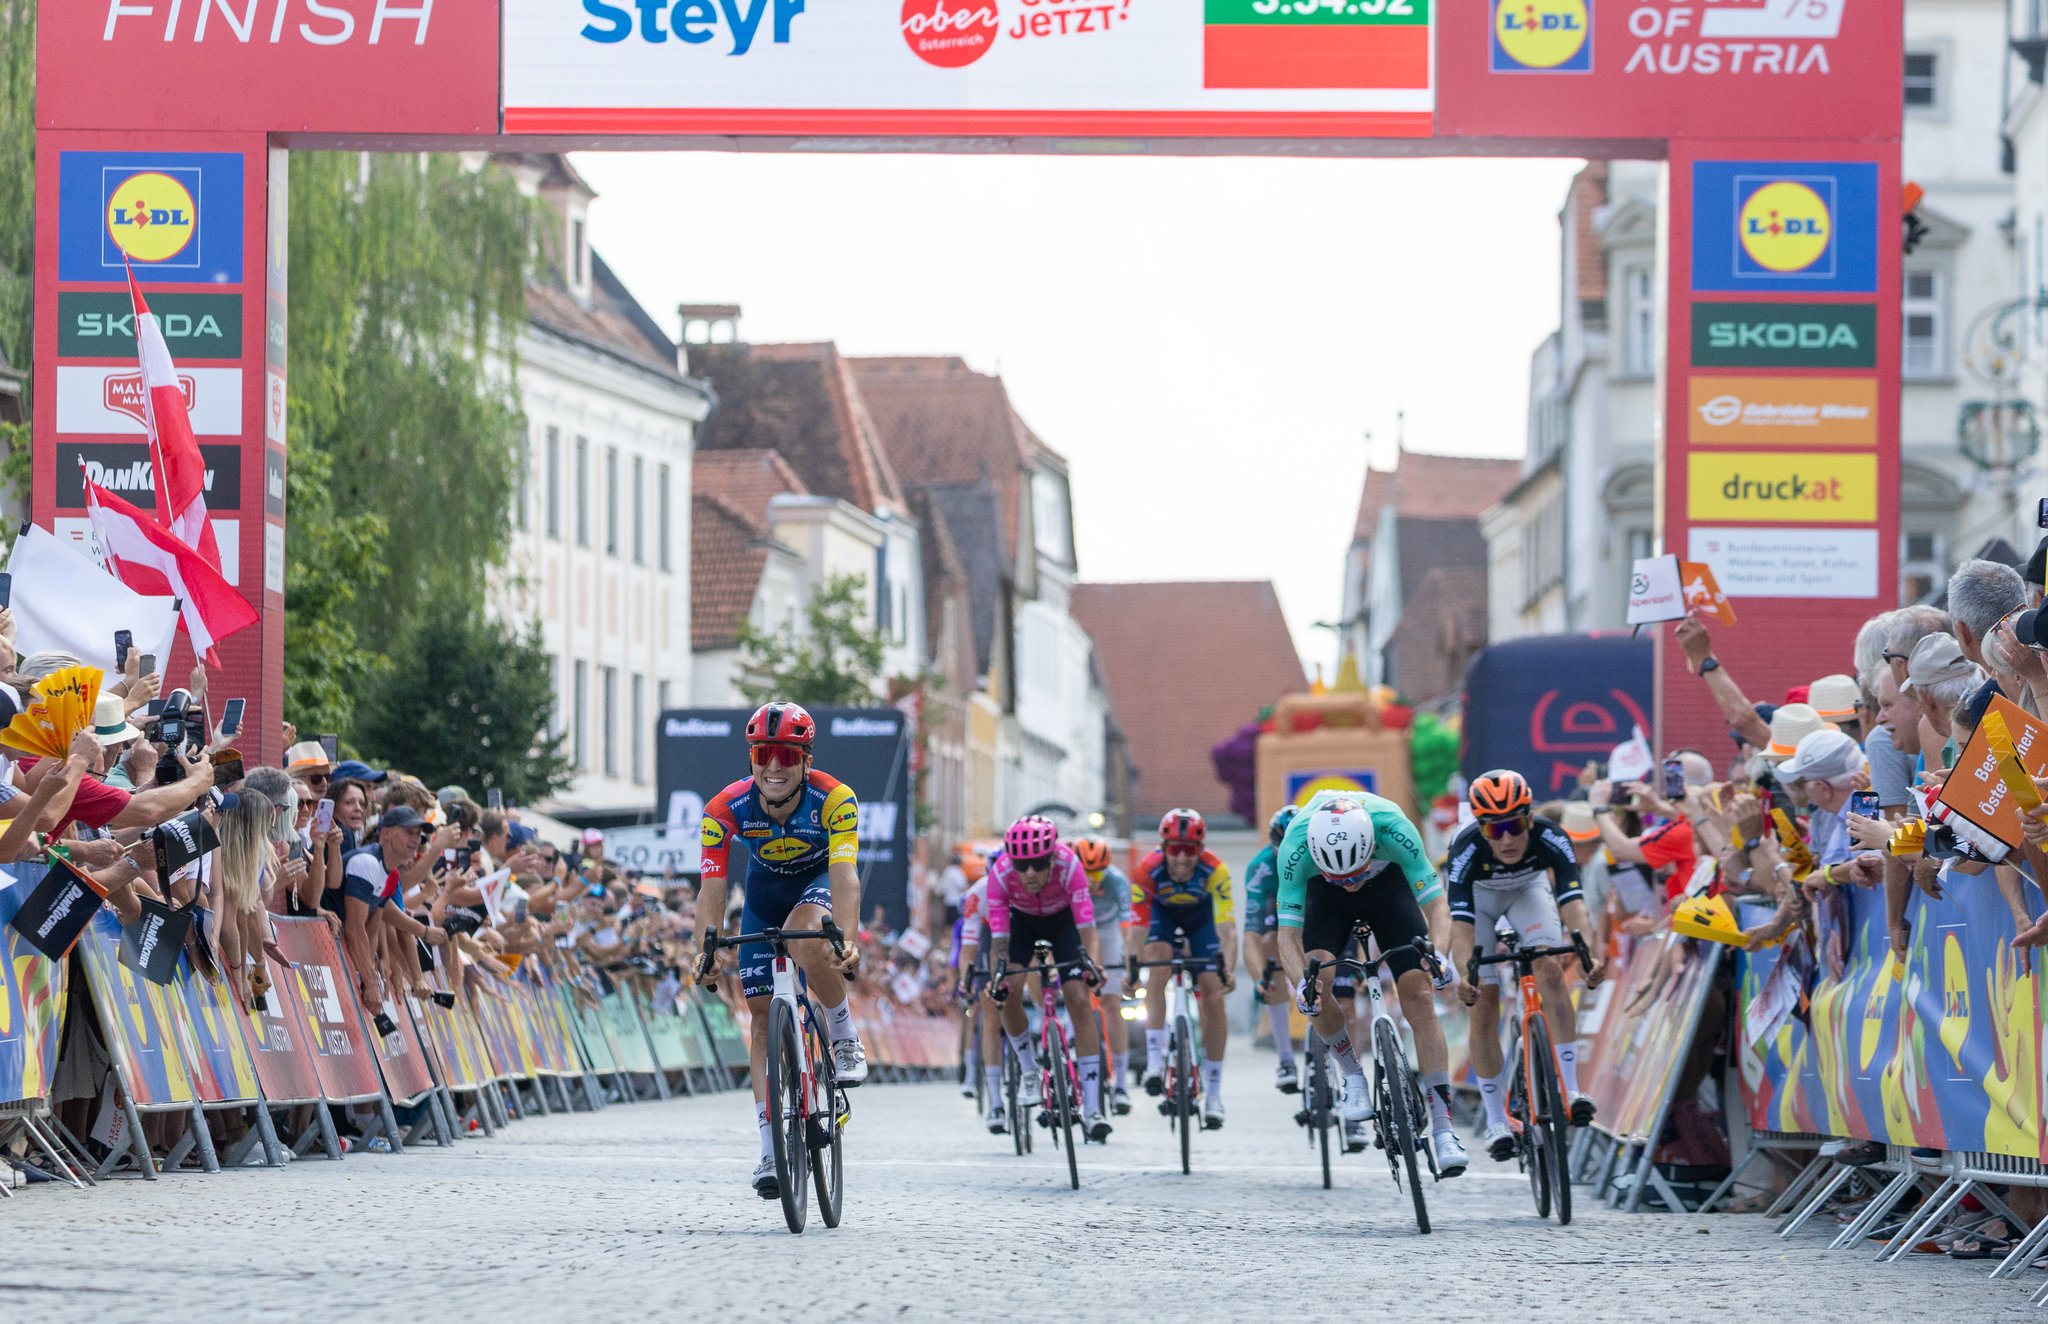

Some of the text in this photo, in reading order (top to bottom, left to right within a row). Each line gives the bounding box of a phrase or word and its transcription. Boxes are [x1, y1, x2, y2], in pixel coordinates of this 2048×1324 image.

[102, 0, 434, 46] FINISH
[580, 0, 805, 56] Steyr
[1628, 7, 1693, 38] OF
[1624, 43, 1830, 75] AUSTRIA
[1722, 473, 1842, 501] druck.at
